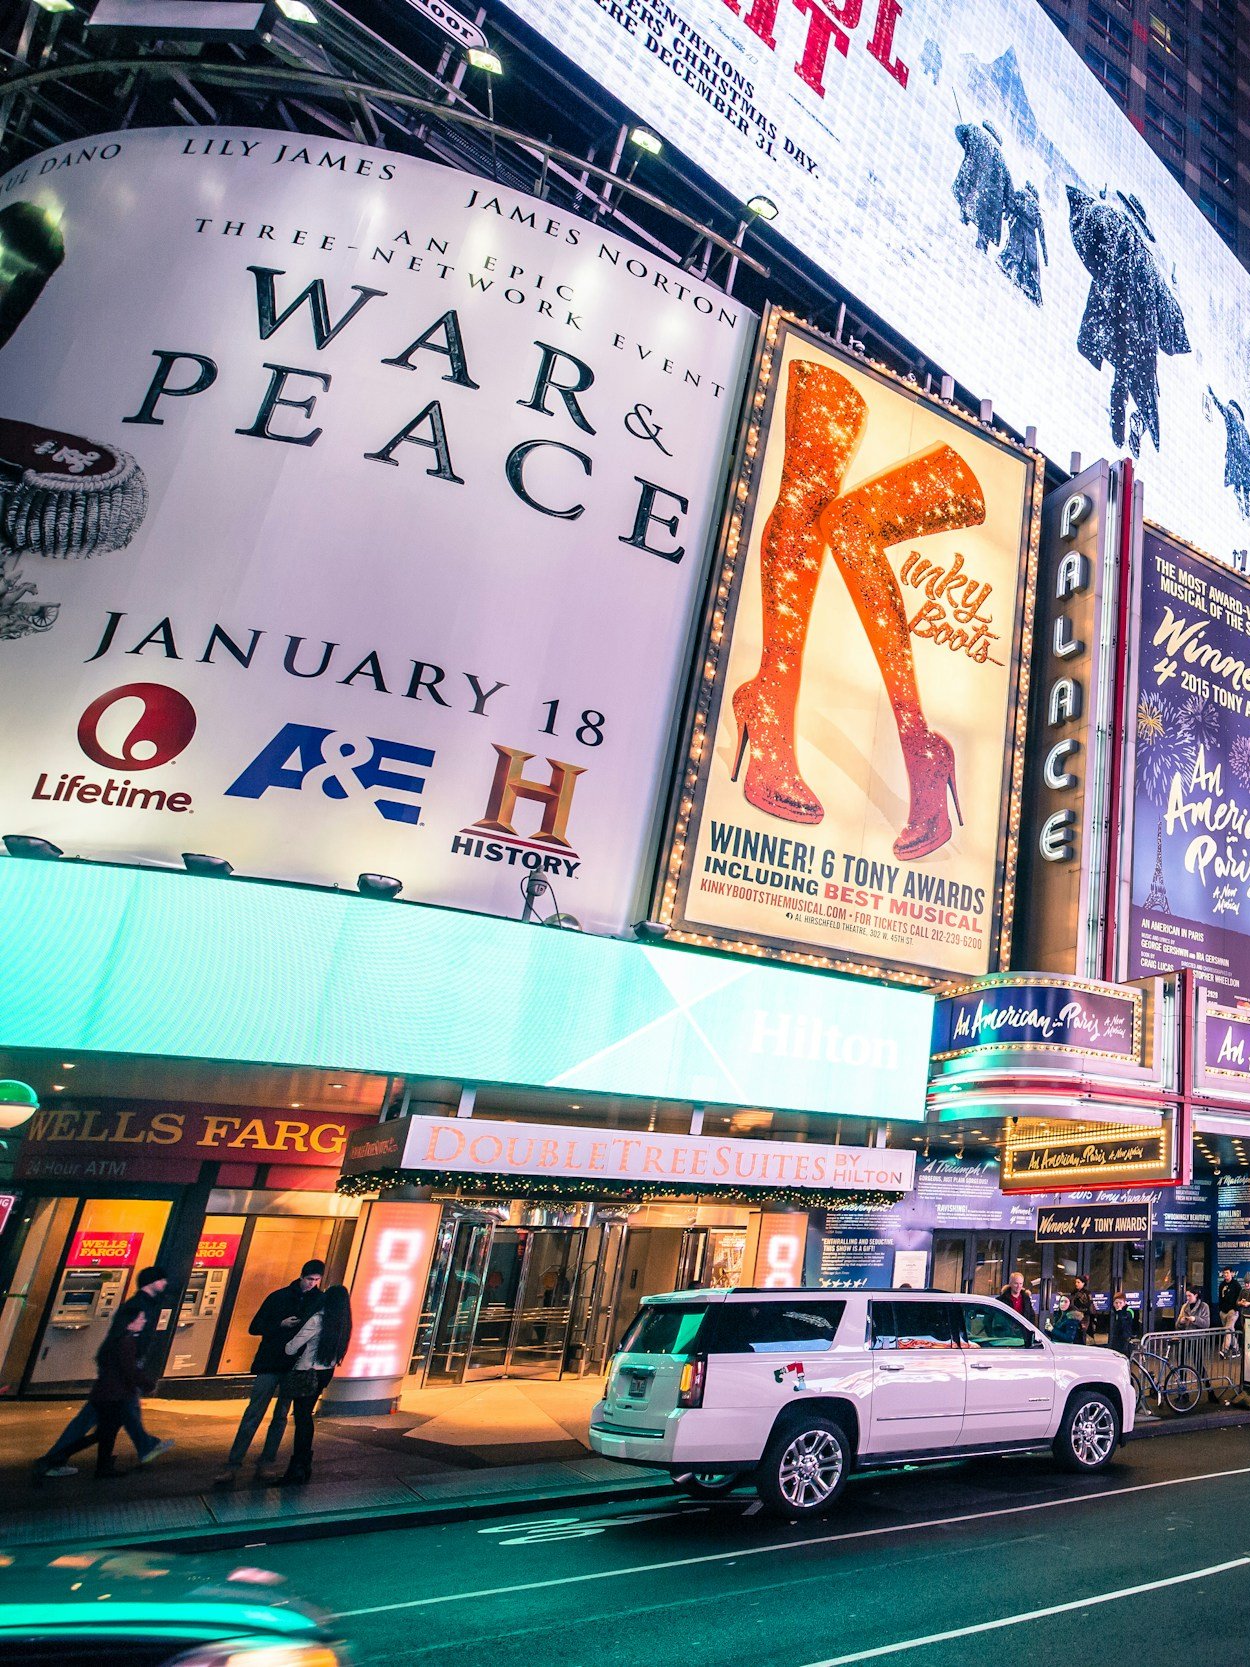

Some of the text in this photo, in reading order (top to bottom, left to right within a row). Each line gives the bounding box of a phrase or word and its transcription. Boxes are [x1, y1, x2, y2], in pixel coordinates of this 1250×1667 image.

[644, 32, 750, 136] DECEMBER
[755, 132, 777, 162] 31.
[672, 37, 778, 139] CHRISTMAS
[782, 136, 820, 179] DAY.
[39, 143, 122, 176] DANO
[182, 138, 397, 181] LILY JAMES
[394, 230, 574, 302] AN EPIC
[464, 189, 737, 329] JAMES NORTON
[194, 218, 725, 399] THREE-NETWORK EVENT
[246, 265, 673, 457] WAR &
[121, 350, 690, 564] PEACE
[1155, 556, 1176, 577] THE
[1179, 568, 1207, 593] MOST
[1161, 577, 1209, 614] MUSICAL
[1210, 607, 1223, 619] OF
[1225, 610, 1244, 632] THE
[908, 599, 1005, 667] Boots
[84, 611, 606, 747] JANUARY 18
[1039, 492, 1091, 862] PALACE
[1154, 658, 1177, 686] 4
[1181, 671, 1209, 699] 2015
[1212, 683, 1243, 713] TONY
[32, 772, 193, 813] Lifetime
[224, 722, 436, 825] A&E
[1189, 743, 1223, 797] An
[451, 834, 580, 879] HISTORY
[1226, 832, 1238, 843] in
[710, 820, 985, 914] WINNER! 6 TONY AWARDS
[700, 878, 846, 920] KINKYBOOTSTHEMUSICAL.COM
[854, 912, 871, 924] FOR
[874, 915, 908, 933] TICKETS
[910, 924, 929, 938] CALL
[704, 856, 982, 933] INCLUDING BEST MUSICAL
[1141, 939, 1229, 967] GEORGE GERSHWIN GERSHWIN
[1150, 920, 1181, 937] AMERICAN
[1187, 929, 1204, 942] PARIS
[953, 999, 1100, 1042] An American in Paris
[1217, 1026, 1244, 1063] An
[27, 1110, 185, 1144] WELLS
[44, 1161, 81, 1175] Hour
[84, 1160, 126, 1176] ATM
[833, 1169, 902, 1184] HILTON
[835, 1153, 861, 1167] BY
[935, 1159, 988, 1178] Triumph!
[81, 1240, 128, 1249] WELLS
[1039, 1215, 1147, 1234] Winner! 4 TONY AWARDS
[79, 1248, 126, 1257] FARGO
